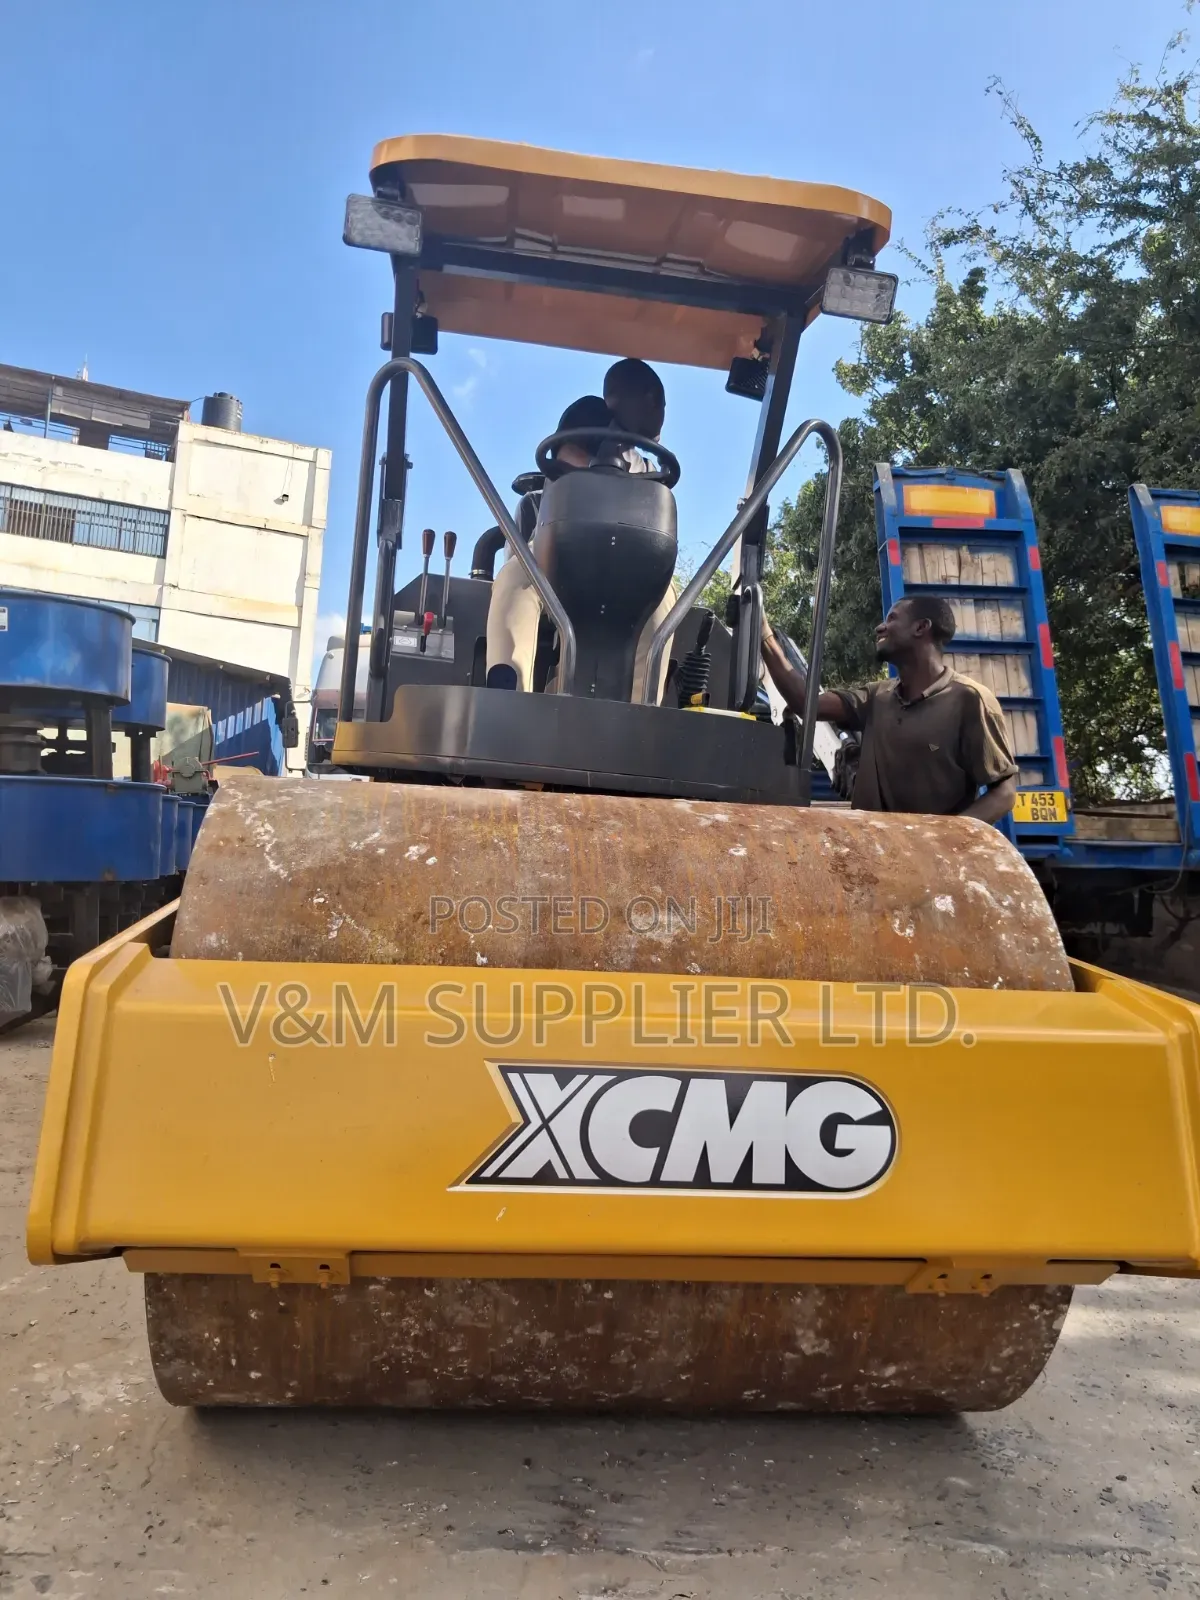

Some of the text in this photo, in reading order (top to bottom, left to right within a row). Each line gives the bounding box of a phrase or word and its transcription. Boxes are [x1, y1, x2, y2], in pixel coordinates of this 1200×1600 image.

[1018, 793, 1056, 807] T 453
[1030, 807, 1058, 821] BQN
[480, 1072, 892, 1188] XCMG
